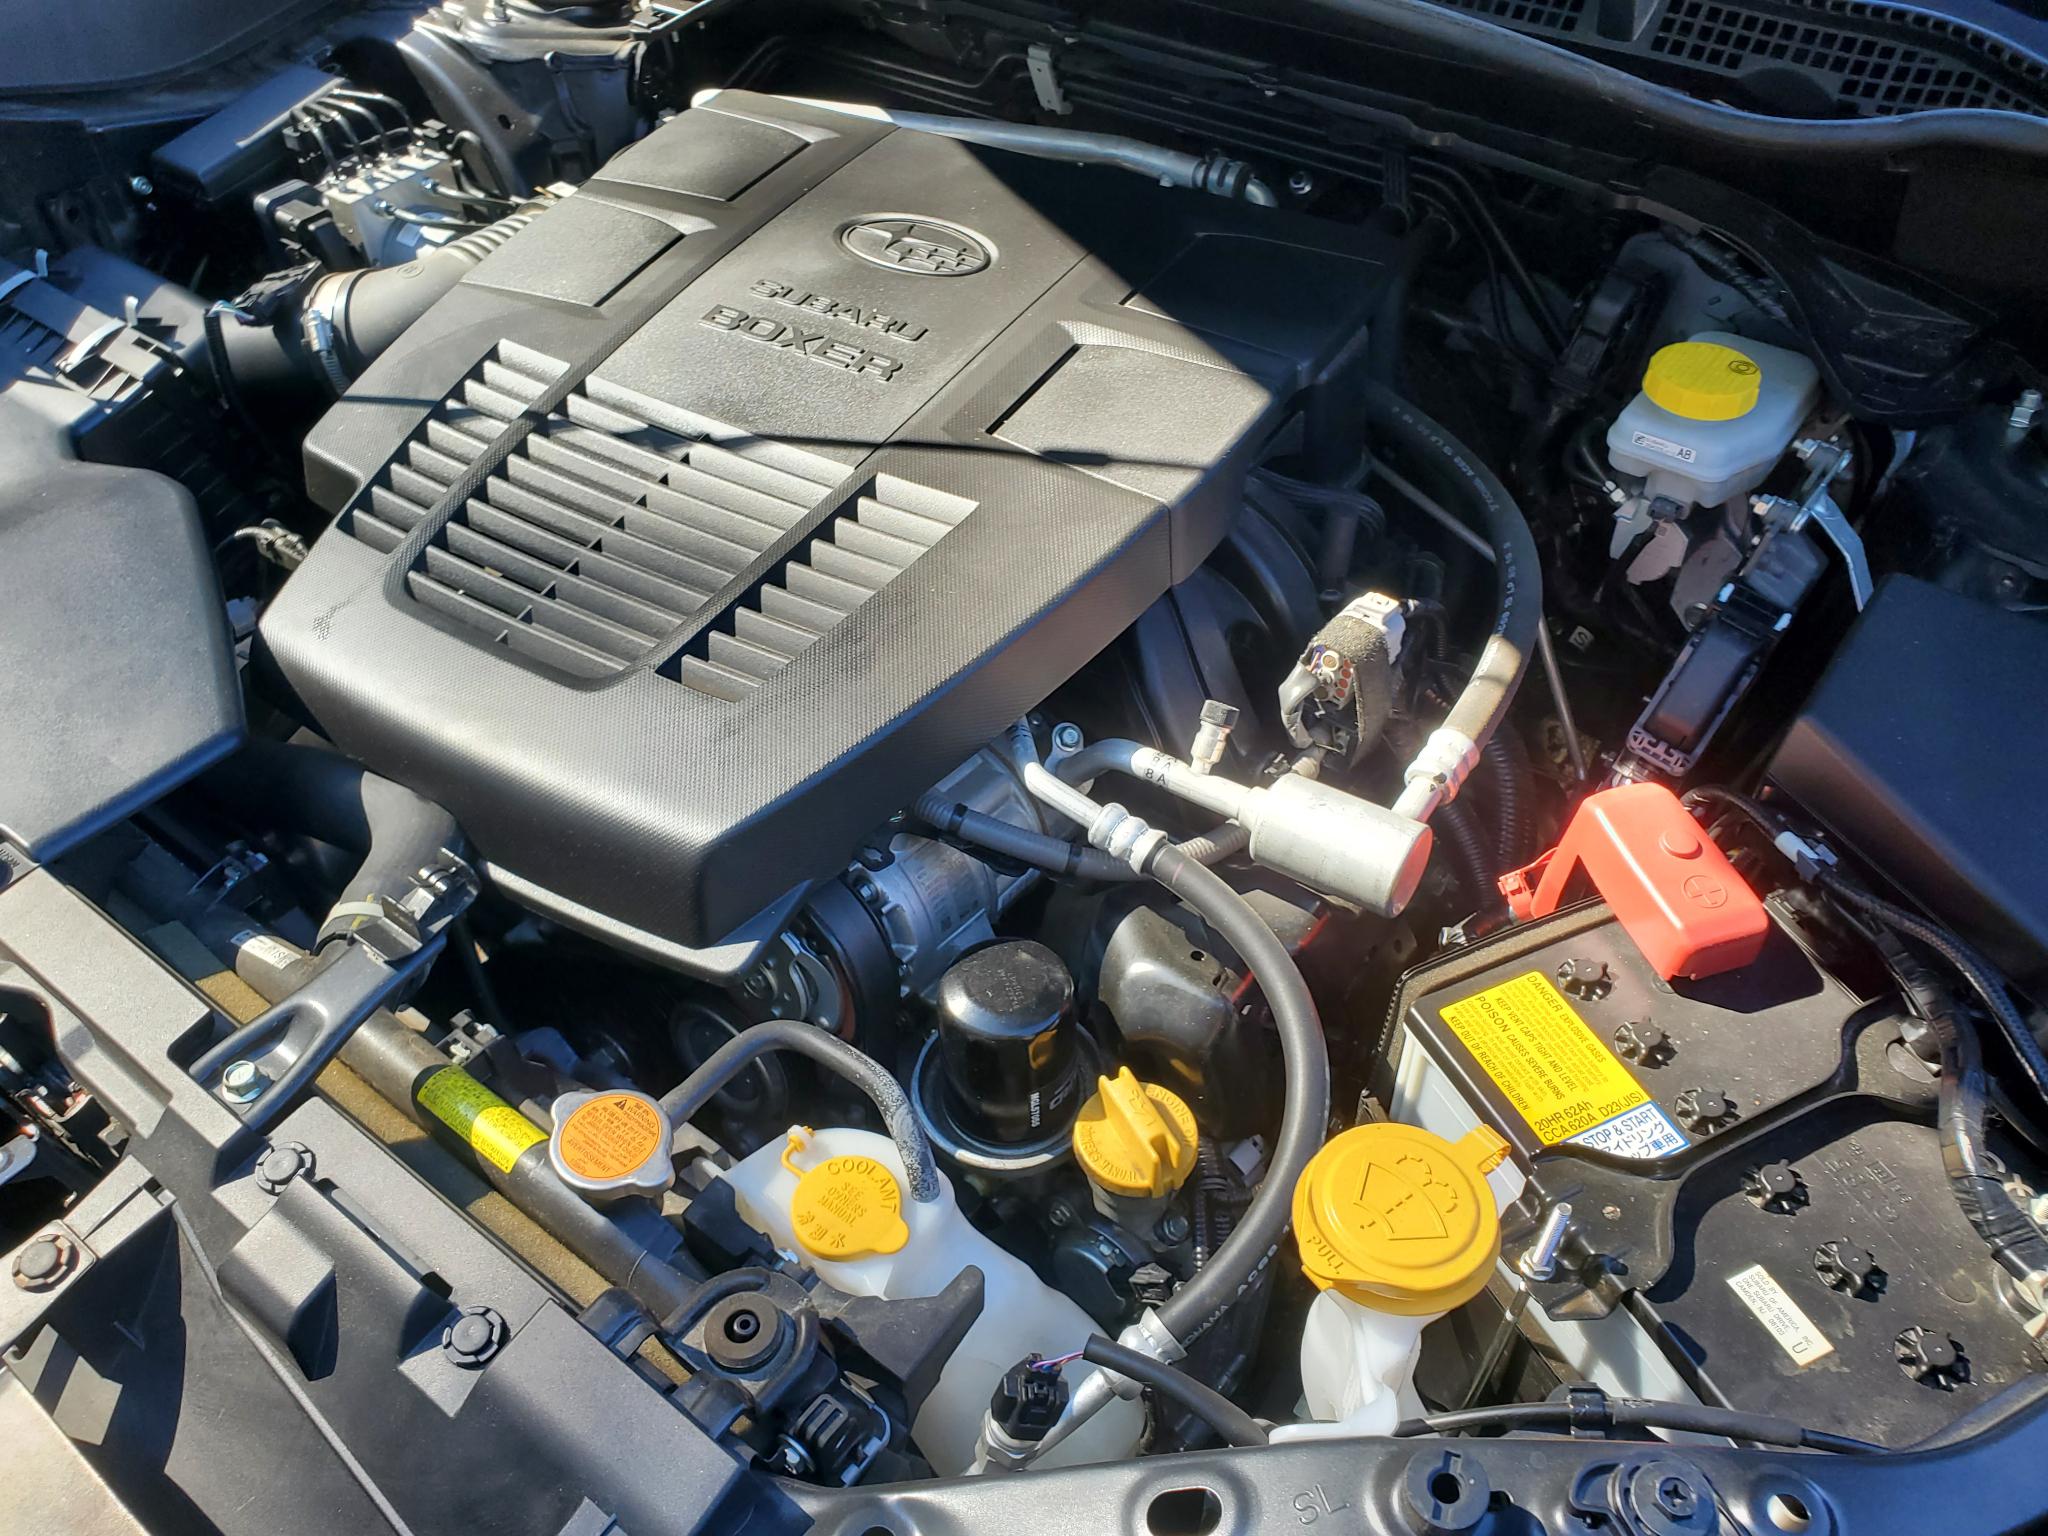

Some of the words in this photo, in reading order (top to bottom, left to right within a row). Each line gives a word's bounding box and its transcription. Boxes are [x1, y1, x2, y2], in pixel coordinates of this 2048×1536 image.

[749, 278, 929, 342] SUBARU
[698, 303, 904, 382] BOXER
[1676, 448, 1692, 461] AB
[1574, 631, 1589, 646] S
[1495, 997, 1512, 1014] KEEP
[1508, 1011, 1524, 1026] VENT
[1520, 1026, 1537, 1043] CAPS
[1534, 1042, 1553, 1060] TIGHT
[1549, 1060, 1563, 1073] AND
[1559, 1073, 1578, 1092] LEVEL
[1526, 975, 1564, 1012] DANGER
[1585, 1042, 1607, 1063] GASES
[1449, 1015, 1466, 1032] KEEP
[1461, 1029, 1476, 1043] OUT
[1471, 1042, 1483, 1052] OF
[1479, 1051, 1497, 1073] REACH
[1494, 1071, 1506, 1082] OF
[1501, 1080, 1530, 1112] CHILDREN
[1475, 995, 1511, 1033] POISON
[1507, 1033, 1530, 1057] CAUSES
[1526, 1056, 1549, 1079] SEVERE
[1544, 1078, 1566, 1100] BURNS
[1534, 1110, 1565, 1132] 20HR
[1563, 1100, 1593, 1119] 62Ah
[1542, 1122, 1571, 1143] CCA
[1567, 1113, 1599, 1131] 620A
[1598, 1091, 1645, 1118] D23(JIS)
[1582, 1128, 1612, 1148] STOP
[1612, 1124, 1623, 1136] &
[1621, 1108, 1657, 1132] START
[827, 1159, 898, 1214] COOLANT
[1305, 1236, 1346, 1275] PULL
[1293, 1484, 1350, 1525] SL
